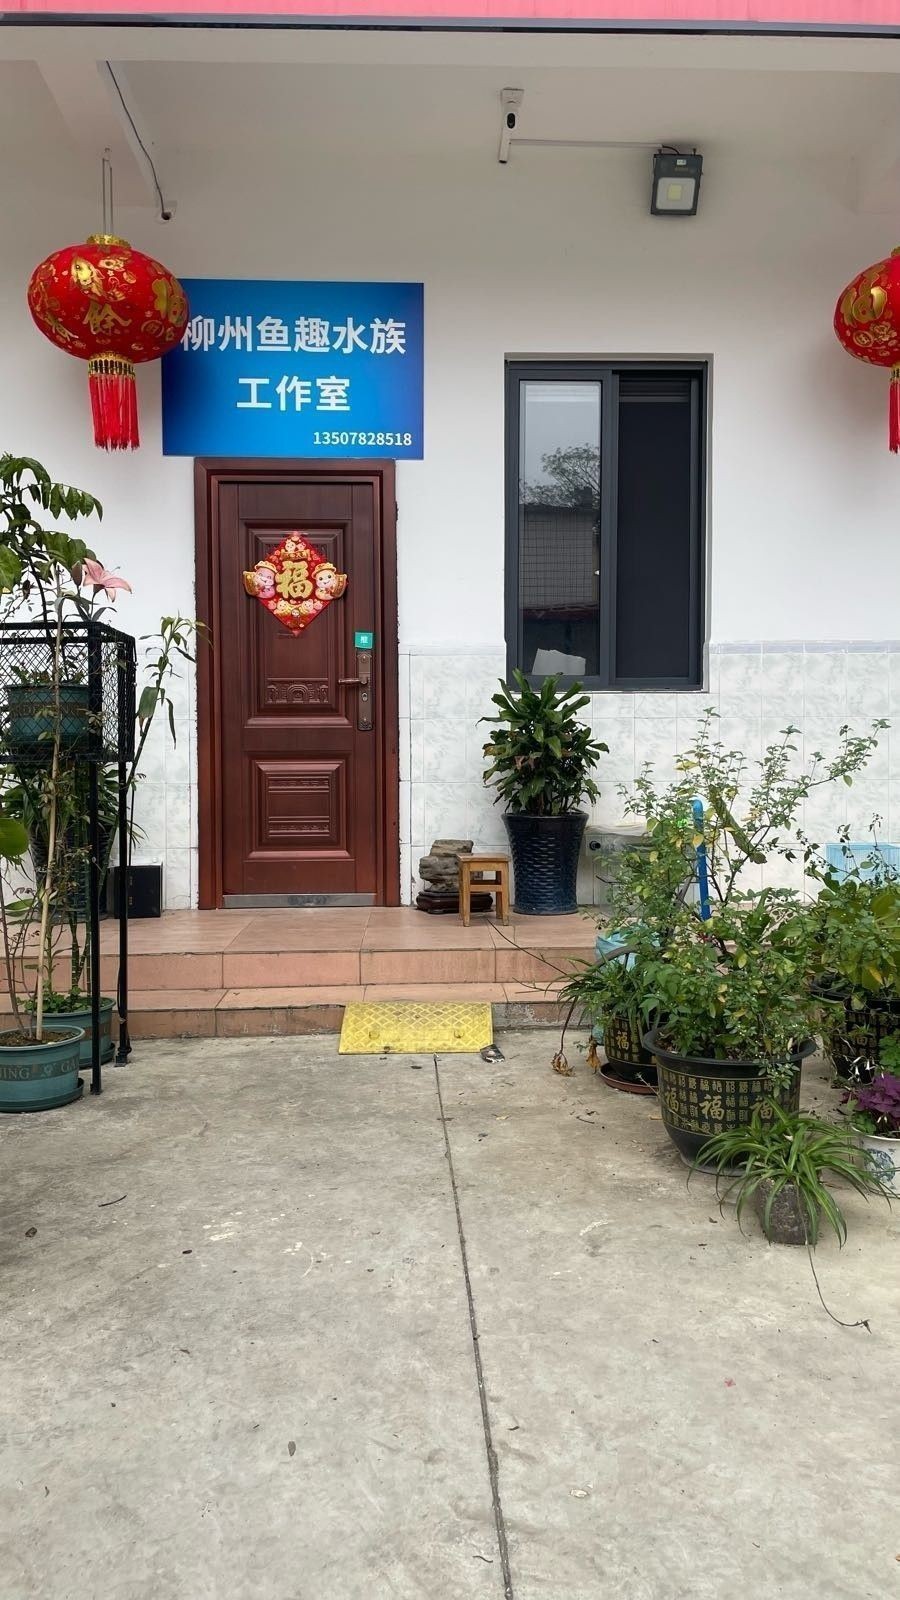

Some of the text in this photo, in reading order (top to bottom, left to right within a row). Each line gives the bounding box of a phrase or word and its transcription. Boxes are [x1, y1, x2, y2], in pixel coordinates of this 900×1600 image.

[180, 315, 407, 355] 柳州鱼趣水族
[236, 375, 351, 412] 工作室
[313, 431, 413, 446] 13507828518
[275, 560, 314, 600] 福
[0, 1066, 30, 1080] ING
[699, 1094, 725, 1121] 福
